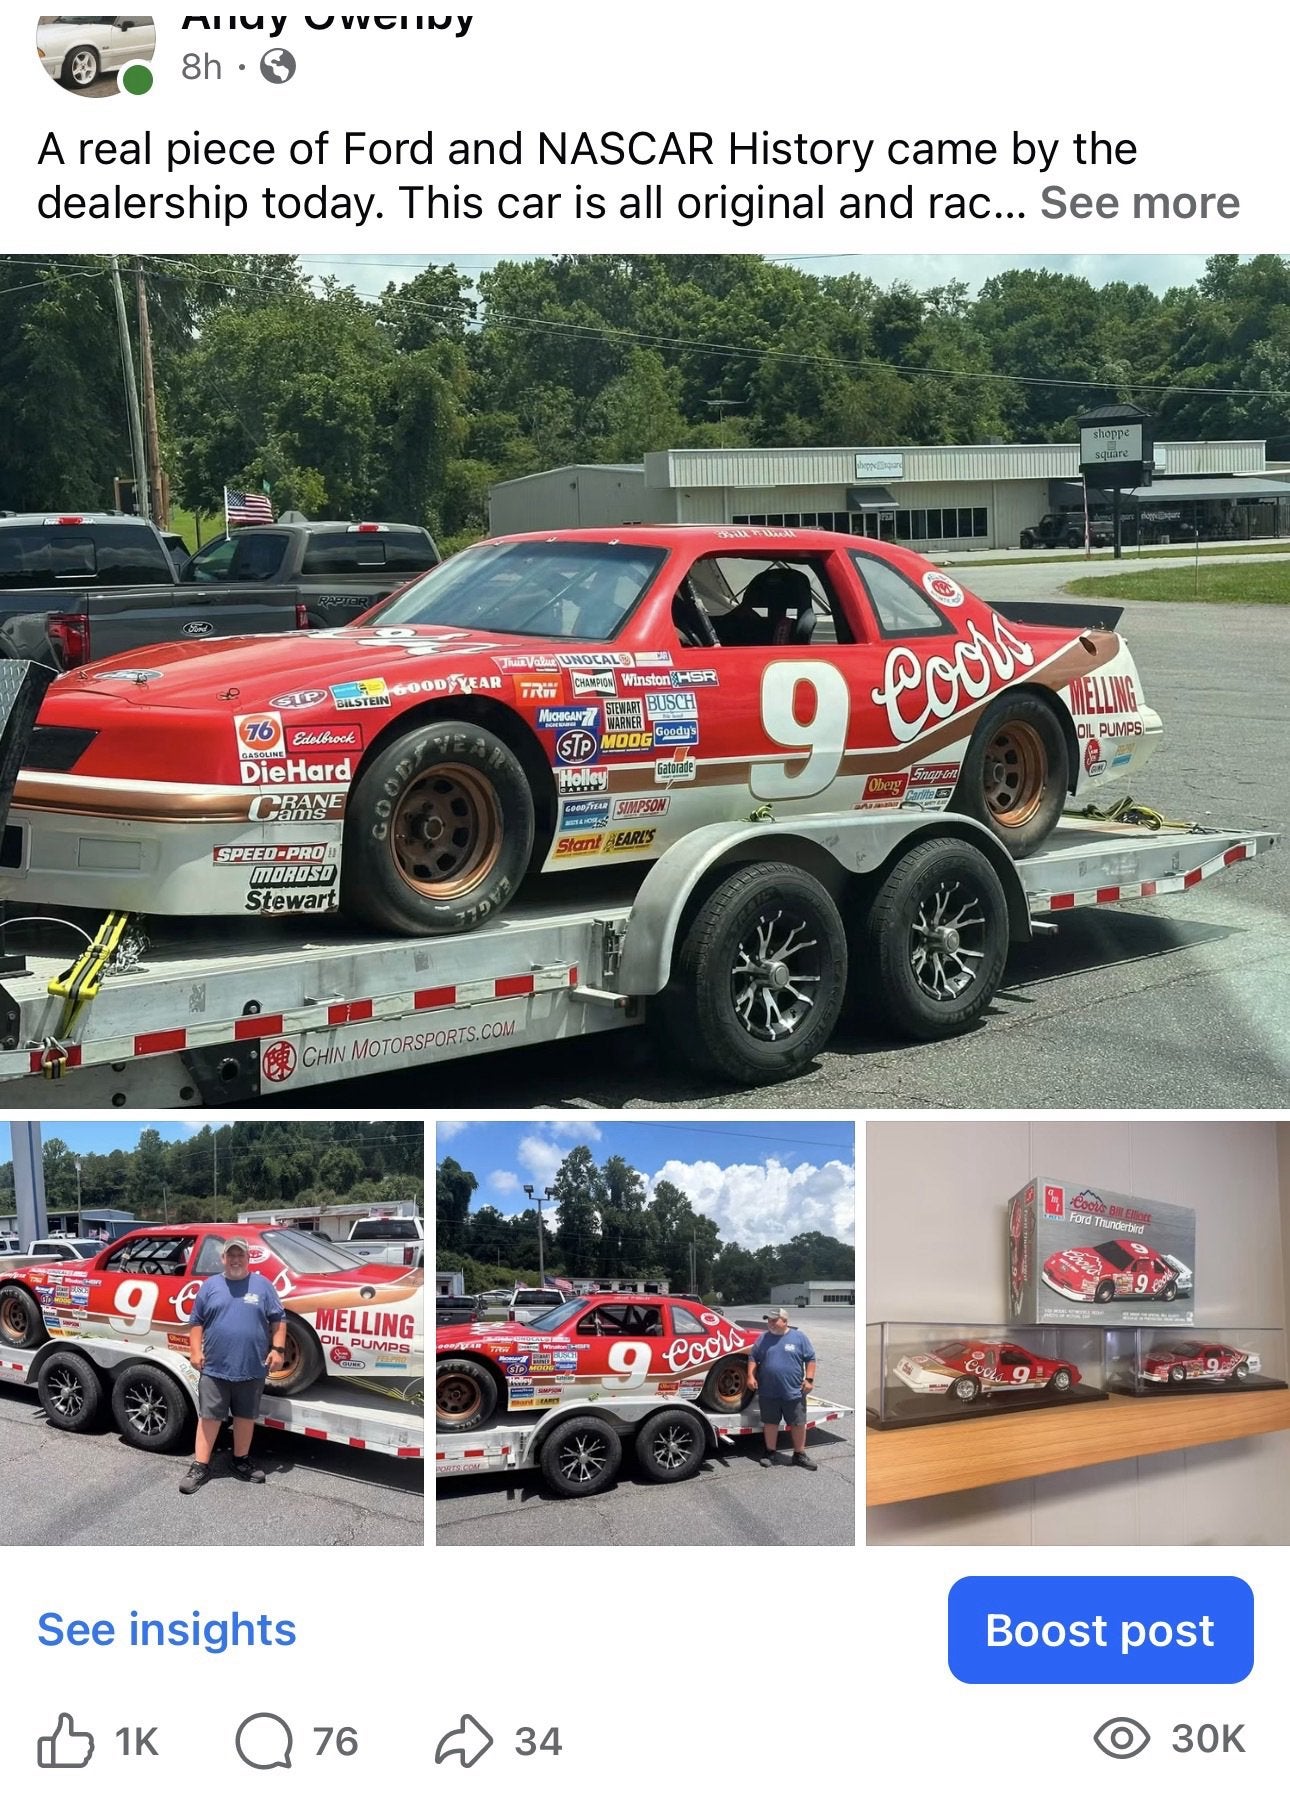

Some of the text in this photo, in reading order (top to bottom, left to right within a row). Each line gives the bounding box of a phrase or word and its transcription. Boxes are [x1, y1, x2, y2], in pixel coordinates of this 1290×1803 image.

[1094, 429, 1130, 441] shoppe
[1096, 450, 1129, 461] square
[318, 595, 369, 609] RAPTOR
[188, 623, 208, 633] Ford
[559, 654, 620, 667] UNOCAL
[392, 674, 501, 695] GOODYEAR
[574, 676, 614, 689] CHAMPION
[621, 672, 671, 687] Winston
[679, 671, 716, 683] HSR
[871, 611, 1034, 742] Coors
[278, 691, 318, 706] STP
[520, 681, 559, 699] TRW
[1069, 675, 1138, 715] MELLING
[336, 695, 389, 709] BILSTEIN
[606, 701, 641, 715] STEWART
[646, 694, 696, 711] BUSCH
[539, 709, 584, 722] MICHIGAN
[607, 716, 642, 729] WARNER
[245, 721, 274, 741] 76
[292, 729, 356, 745] Edelbrock
[656, 726, 697, 739] Goody's
[749, 659, 849, 802] 9
[1077, 721, 1143, 739] OIL PUMPS
[561, 734, 592, 757] STP
[600, 732, 653, 749] MOOG
[241, 751, 284, 759] GASOLINE
[240, 758, 350, 784] DieHard
[657, 760, 694, 775] Gatorade
[911, 767, 959, 783] Snap-on
[560, 768, 607, 790] Holley
[868, 777, 902, 796] Oberg
[905, 788, 936, 801] Carlite
[565, 801, 609, 812] GOODYEAR
[616, 799, 667, 815] SIMPSON
[556, 834, 602, 853] Stant
[614, 829, 656, 846] EARL'S
[216, 845, 326, 863] SPEED-PRO
[250, 865, 337, 888] MOROSO
[245, 889, 336, 911] Stewart
[302, 1020, 516, 1068] CHIN MOTORSPORTS.COM
[1071, 1195, 1105, 1213] Coors
[1109, 1205, 1124, 1217] Bill
[1070, 1212, 1145, 1235] Ford Thunderbird
[1131, 1243, 1149, 1254] 9
[1134, 1274, 1149, 1293] 9
[108, 1279, 160, 1335] 9
[315, 1307, 415, 1339] MELLING
[321, 1335, 410, 1354] OIL PUMPS
[662, 1328, 745, 1373] Coors
[510, 1364, 525, 1374] STP
[601, 1340, 653, 1390] 9
[963, 1358, 1005, 1382] Coors
[1206, 1358, 1219, 1372] 9
[509, 1376, 532, 1386] Holley
[1010, 1366, 1031, 1384] 9
